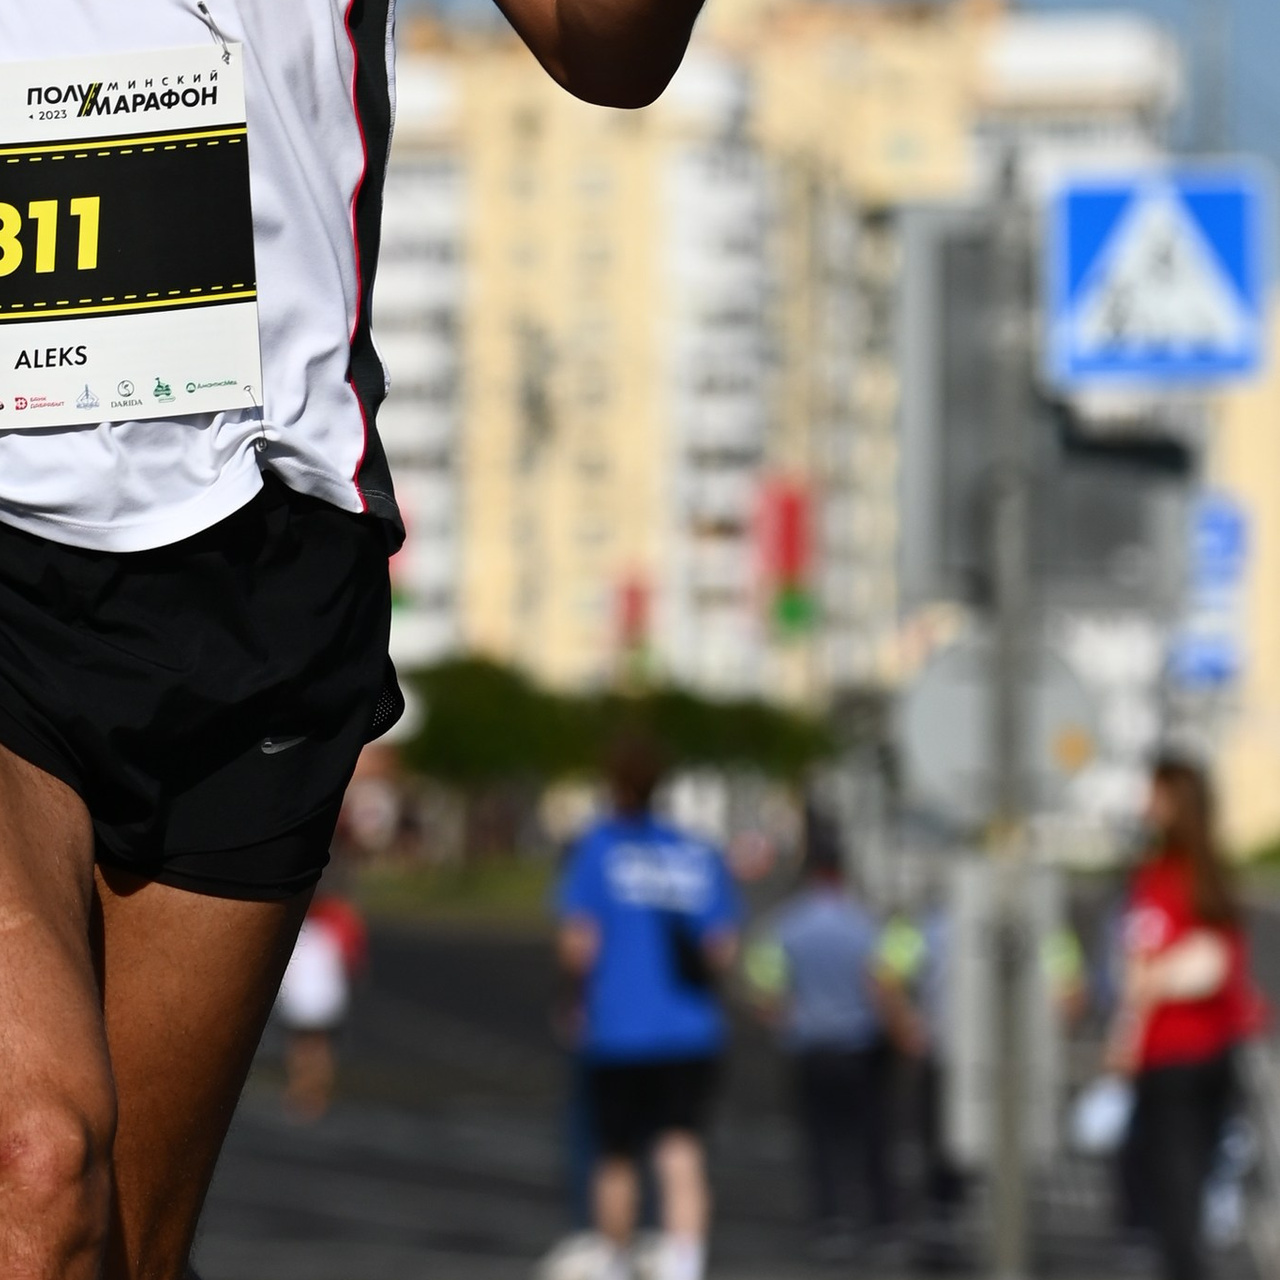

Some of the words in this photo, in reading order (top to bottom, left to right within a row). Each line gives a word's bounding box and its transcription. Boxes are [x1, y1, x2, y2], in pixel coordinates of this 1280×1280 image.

[107, 70, 218, 91] МИНСКИЙ
[27, 83, 103, 115] ПОЛУ
[82, 86, 218, 117] МАРАФОН
[39, 110, 67, 120] 2023
[14, 345, 88, 370] ALEKS
[110, 399, 143, 409] DARIDA
